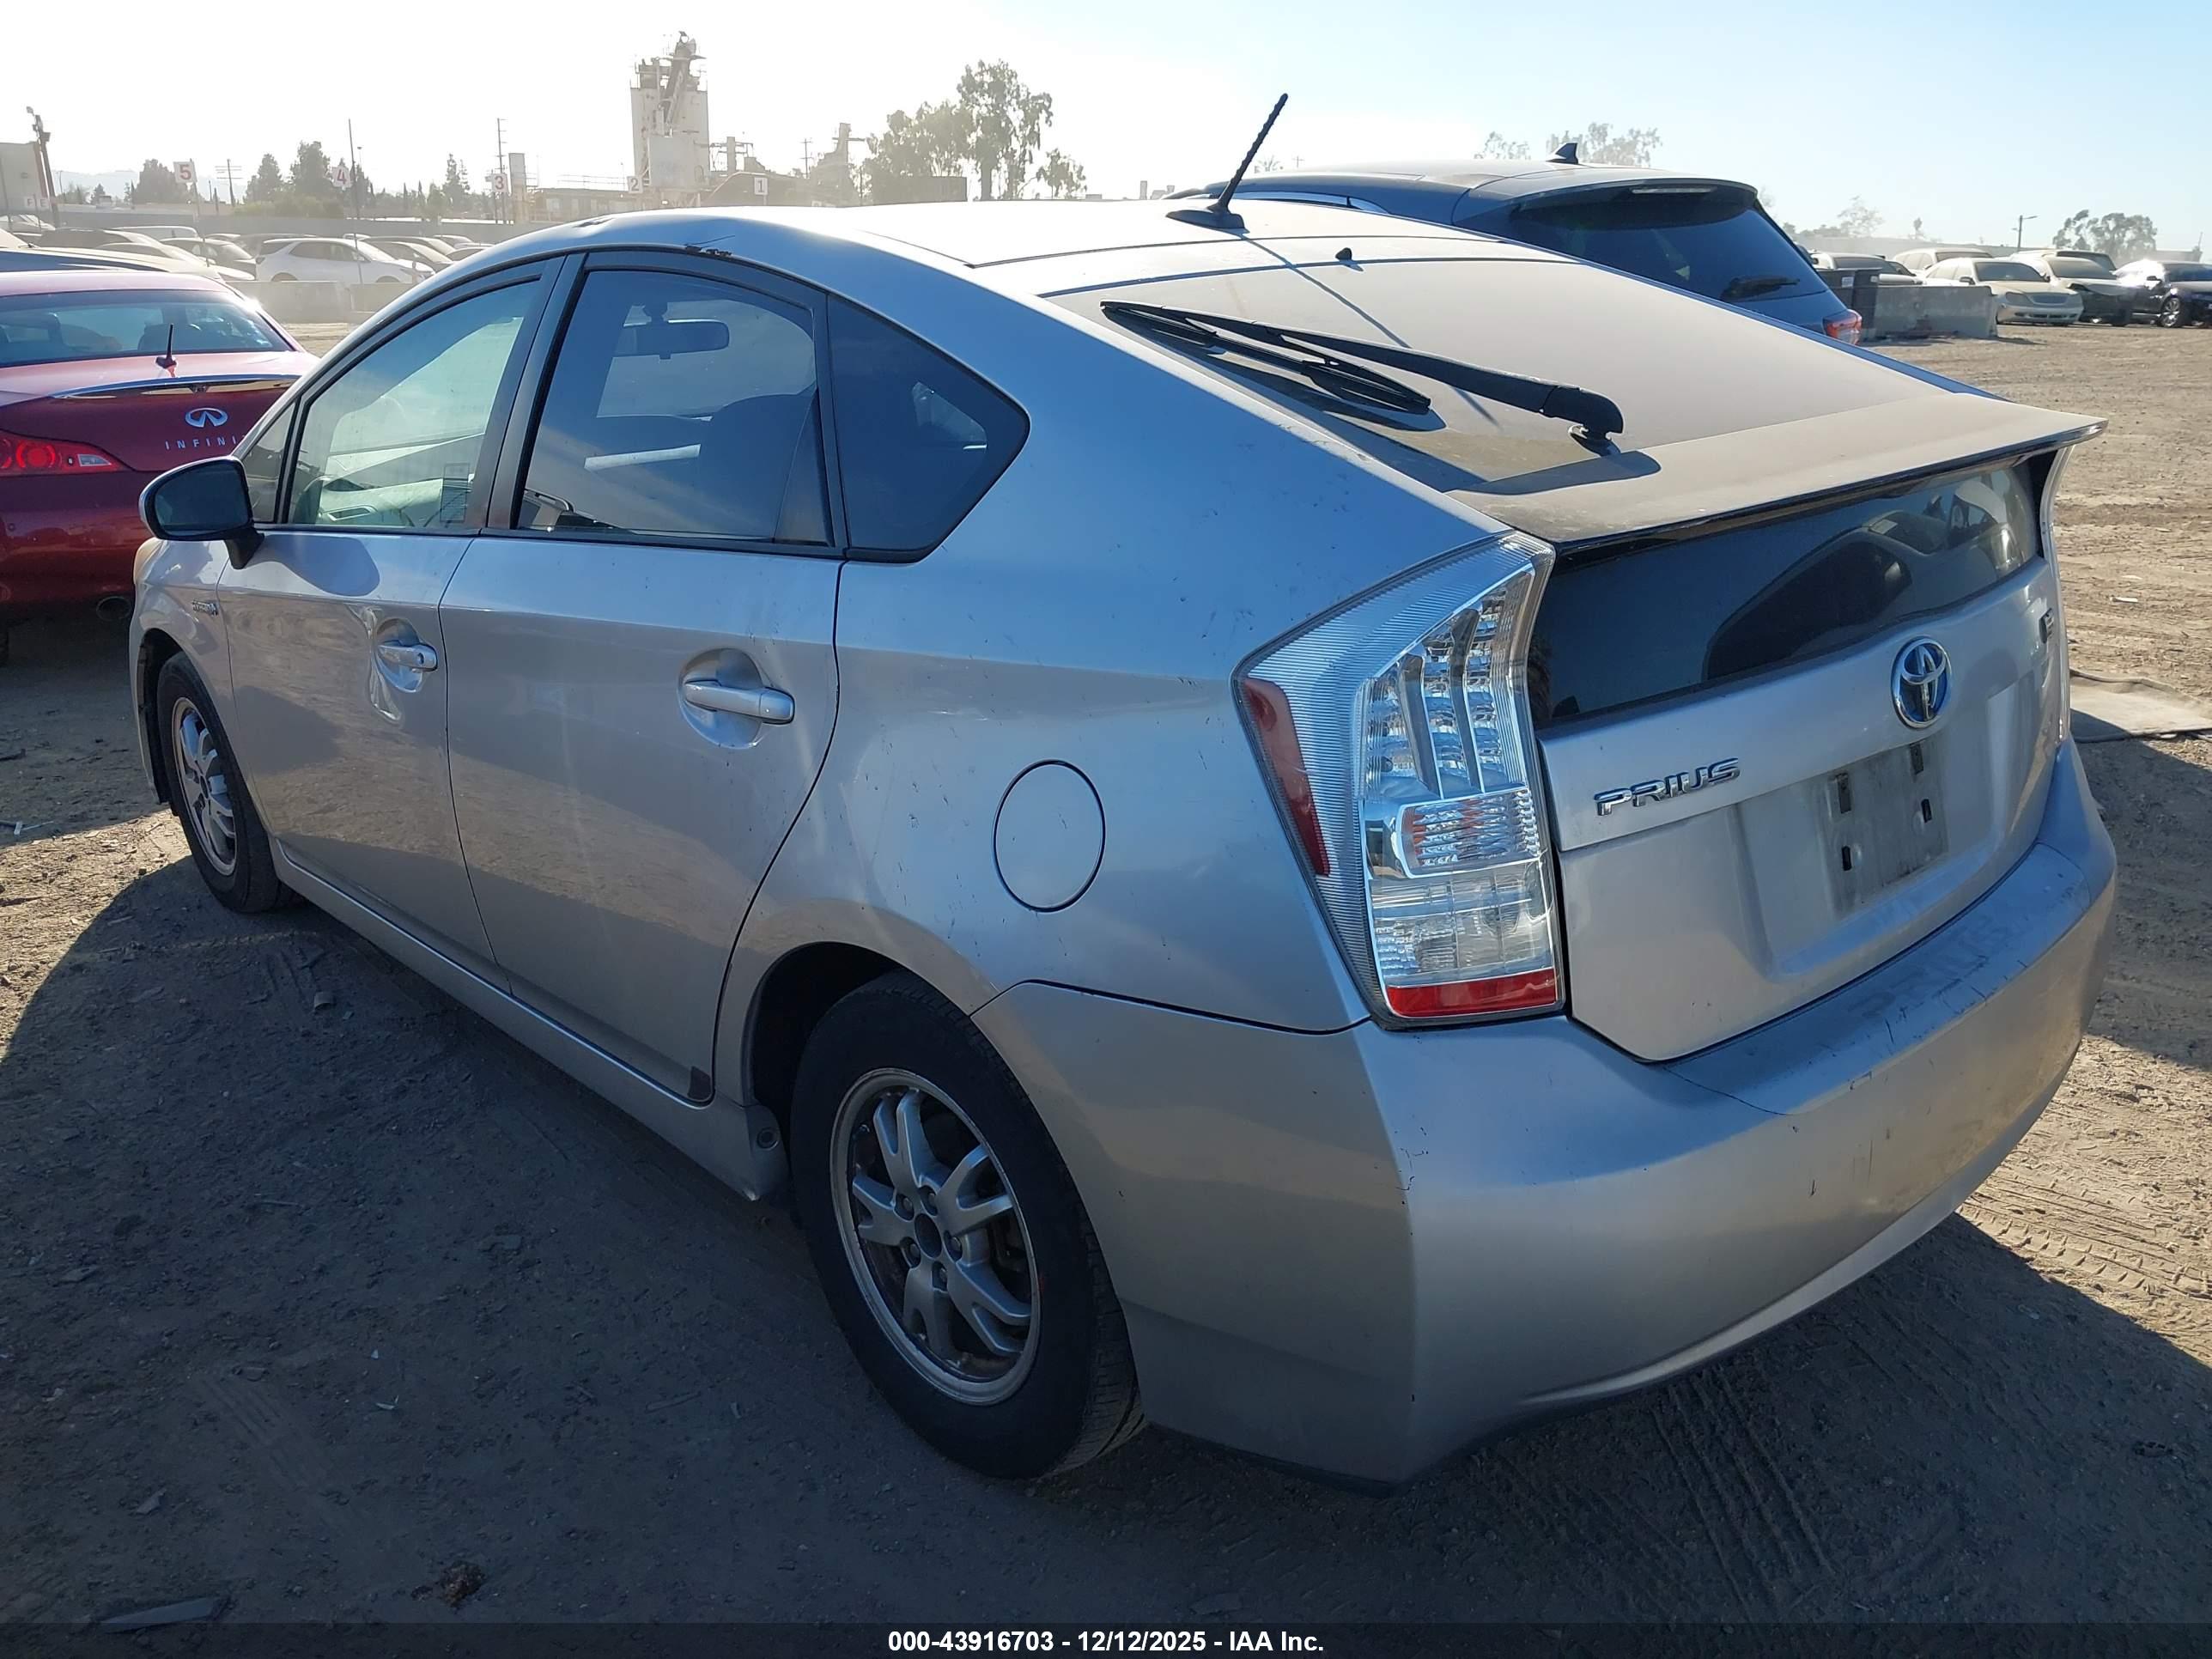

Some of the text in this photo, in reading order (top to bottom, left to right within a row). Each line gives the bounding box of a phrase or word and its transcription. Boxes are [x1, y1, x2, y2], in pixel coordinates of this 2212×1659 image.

[179, 164, 192, 180] 5
[336, 168, 347, 185] 4
[494, 175, 504, 190] 3
[629, 177, 640, 191] 2
[757, 179, 765, 193] 1
[164, 434, 246, 450] INFINI
[1594, 757, 1741, 816] PRIUS
